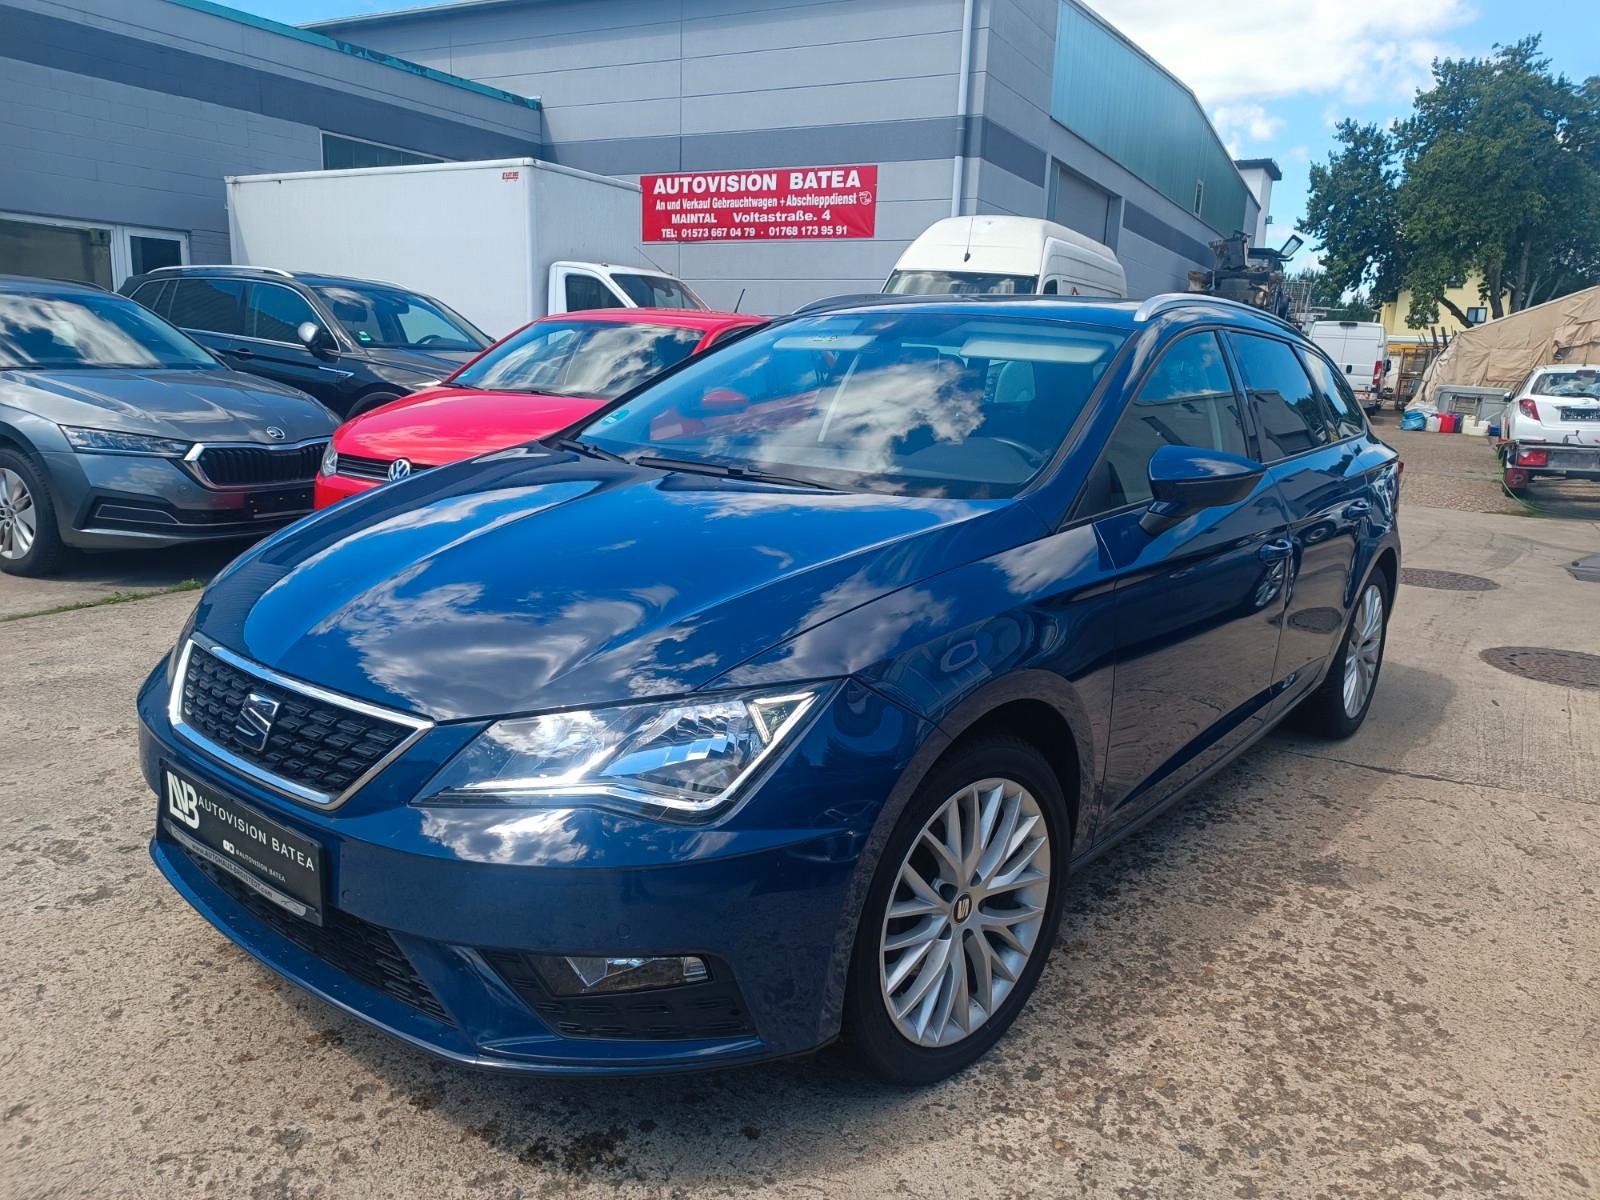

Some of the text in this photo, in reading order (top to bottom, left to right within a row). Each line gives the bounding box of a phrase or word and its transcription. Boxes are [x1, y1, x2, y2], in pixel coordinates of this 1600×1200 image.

[653, 170, 861, 194] AUTOVISION BATEA
[656, 199, 666, 211] An
[667, 198, 681, 210] und
[682, 197, 711, 209] Verkauf
[712, 196, 778, 210] Gebrauchtwagen
[671, 213, 718, 224] MAINTAL
[821, 209, 831, 221] 4
[661, 225, 848, 238] TEL: 01573 667 04 79 01768 173 95 91
[198, 795, 267, 845] AUTOVISION
[271, 836, 315, 872] BATEA
